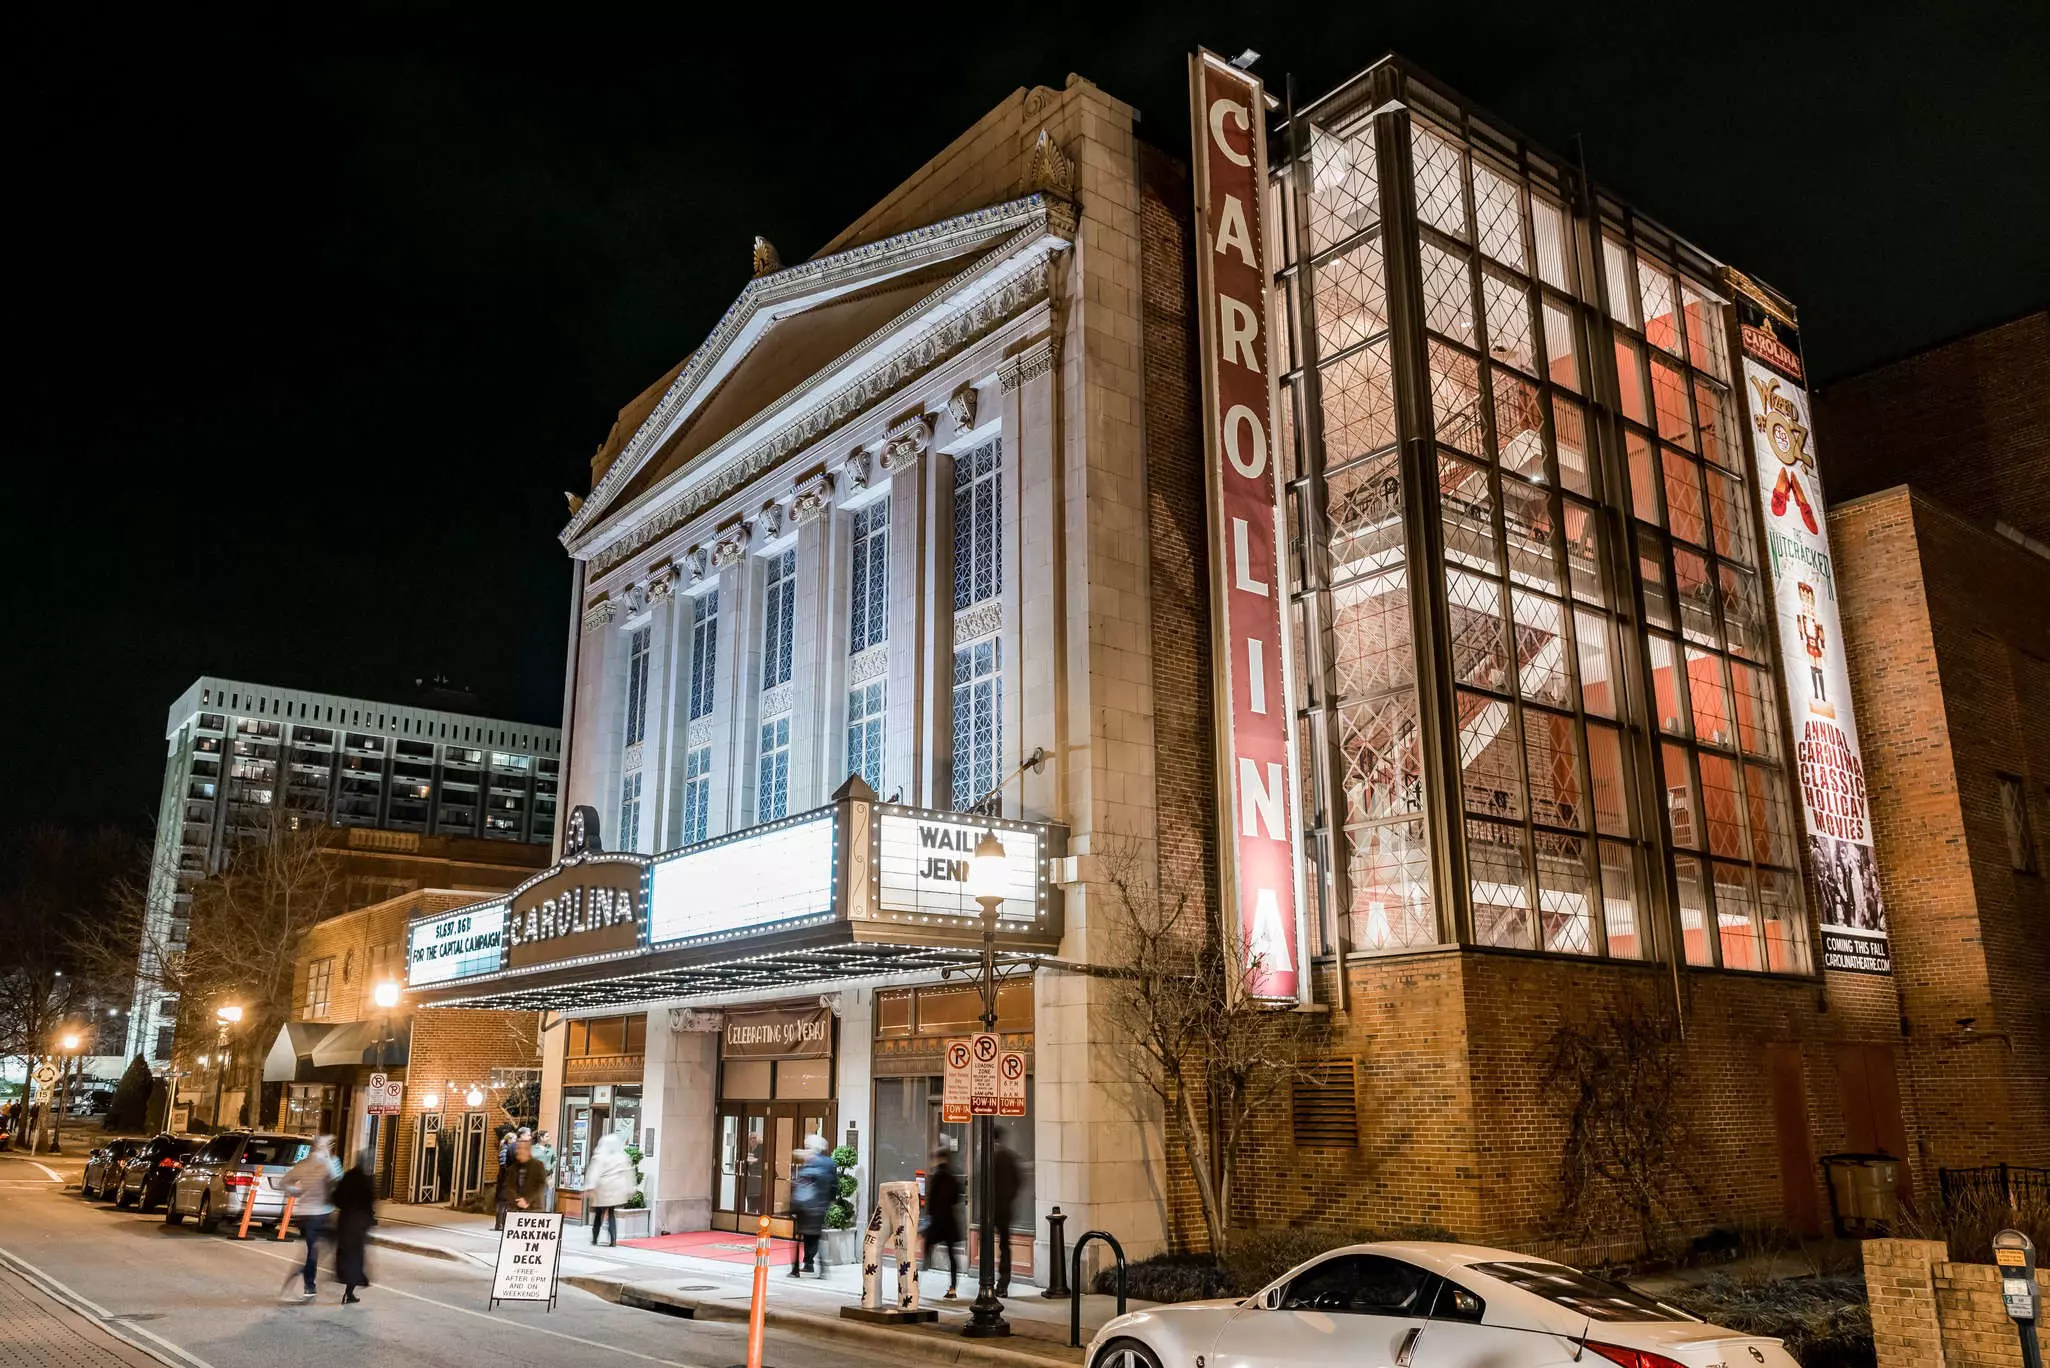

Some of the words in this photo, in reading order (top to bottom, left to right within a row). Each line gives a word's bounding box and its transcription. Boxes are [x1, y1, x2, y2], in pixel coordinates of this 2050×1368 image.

[1744, 329, 1799, 371] CAROLINA
[1209, 98, 1292, 972] CAROLINA
[1769, 531, 1835, 601] NUTCRACKER
[1805, 721, 1850, 753] ANNUAL
[1798, 742, 1863, 778] CAROLINA
[1800, 763, 1865, 798] CLASSIC
[1804, 786, 1865, 819] HOLIDAY
[1812, 809, 1864, 840] MOVIES
[510, 885, 636, 946] CAROLINA
[412, 948, 424, 963] FOR
[426, 945, 438, 960] THE
[439, 939, 464, 957] CAPITAL
[465, 931, 501, 952] CAMPAIGN
[1825, 953, 1891, 971] CAROLINATHEATRE.COM
[1826, 937, 1853, 953] COMING
[1854, 940, 1870, 955] THIS
[1870, 942, 1886, 956] FALL
[727, 1023, 781, 1045] CELEBRATING
[783, 1023, 795, 1045] 90
[796, 1019, 827, 1041] YEARS
[506, 1230, 556, 1240] PARKING
[517, 1218, 551, 1228] EVENT
[513, 1255, 542, 1264] DECK
[525, 1242, 539, 1252] IN
